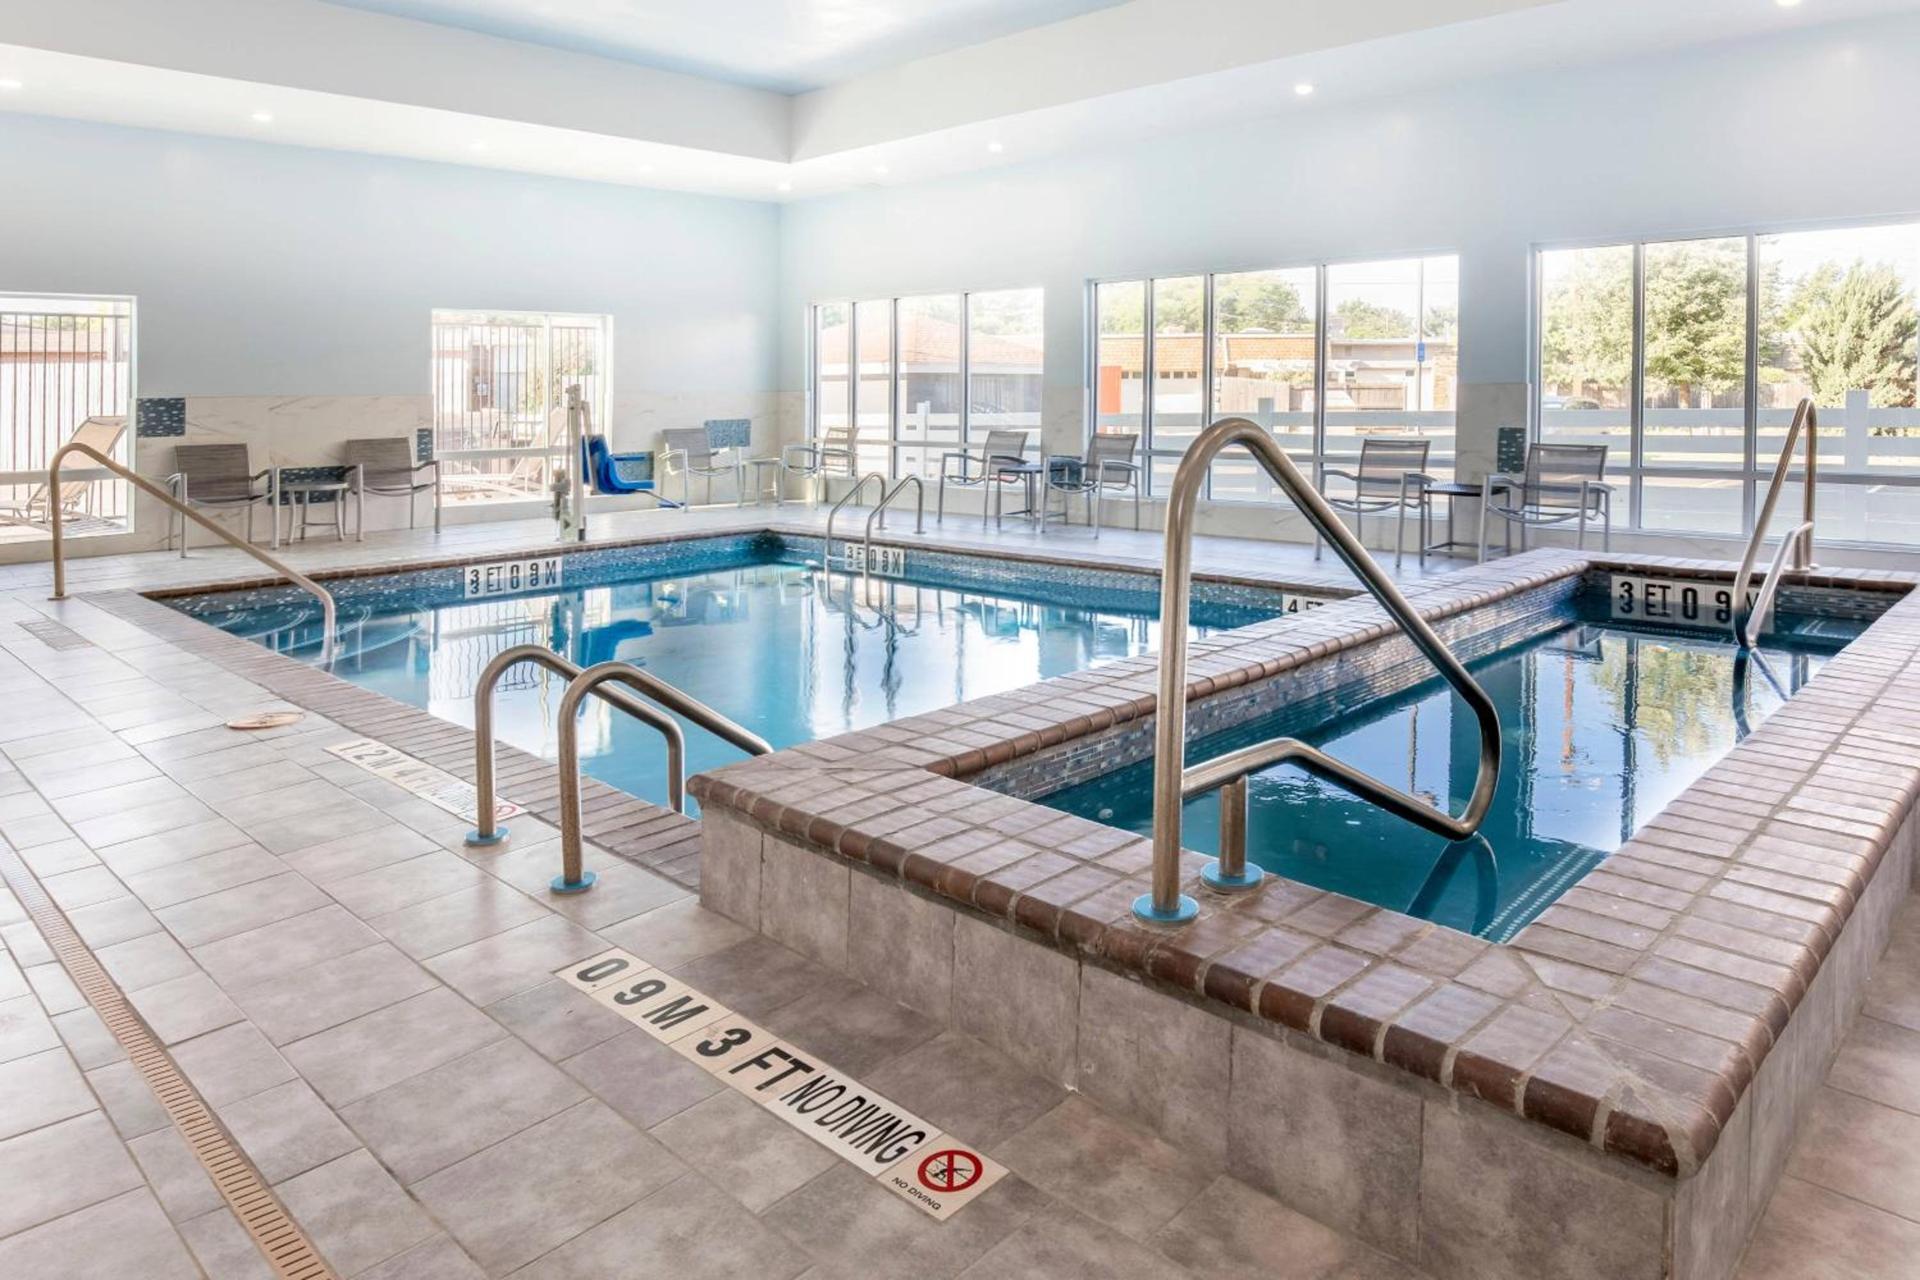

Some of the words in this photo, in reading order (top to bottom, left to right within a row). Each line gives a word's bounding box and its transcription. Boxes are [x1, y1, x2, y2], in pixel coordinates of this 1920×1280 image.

[1288, 599, 1298, 613] 4
[641, 995, 710, 1030] M
[695, 1028, 752, 1057] 3
[728, 1046, 816, 1091] FT
[779, 1074, 847, 1114] NO
[814, 1095, 926, 1164] DIVING
[891, 1177, 908, 1189] NO
[907, 1187, 942, 1211] DIVING
